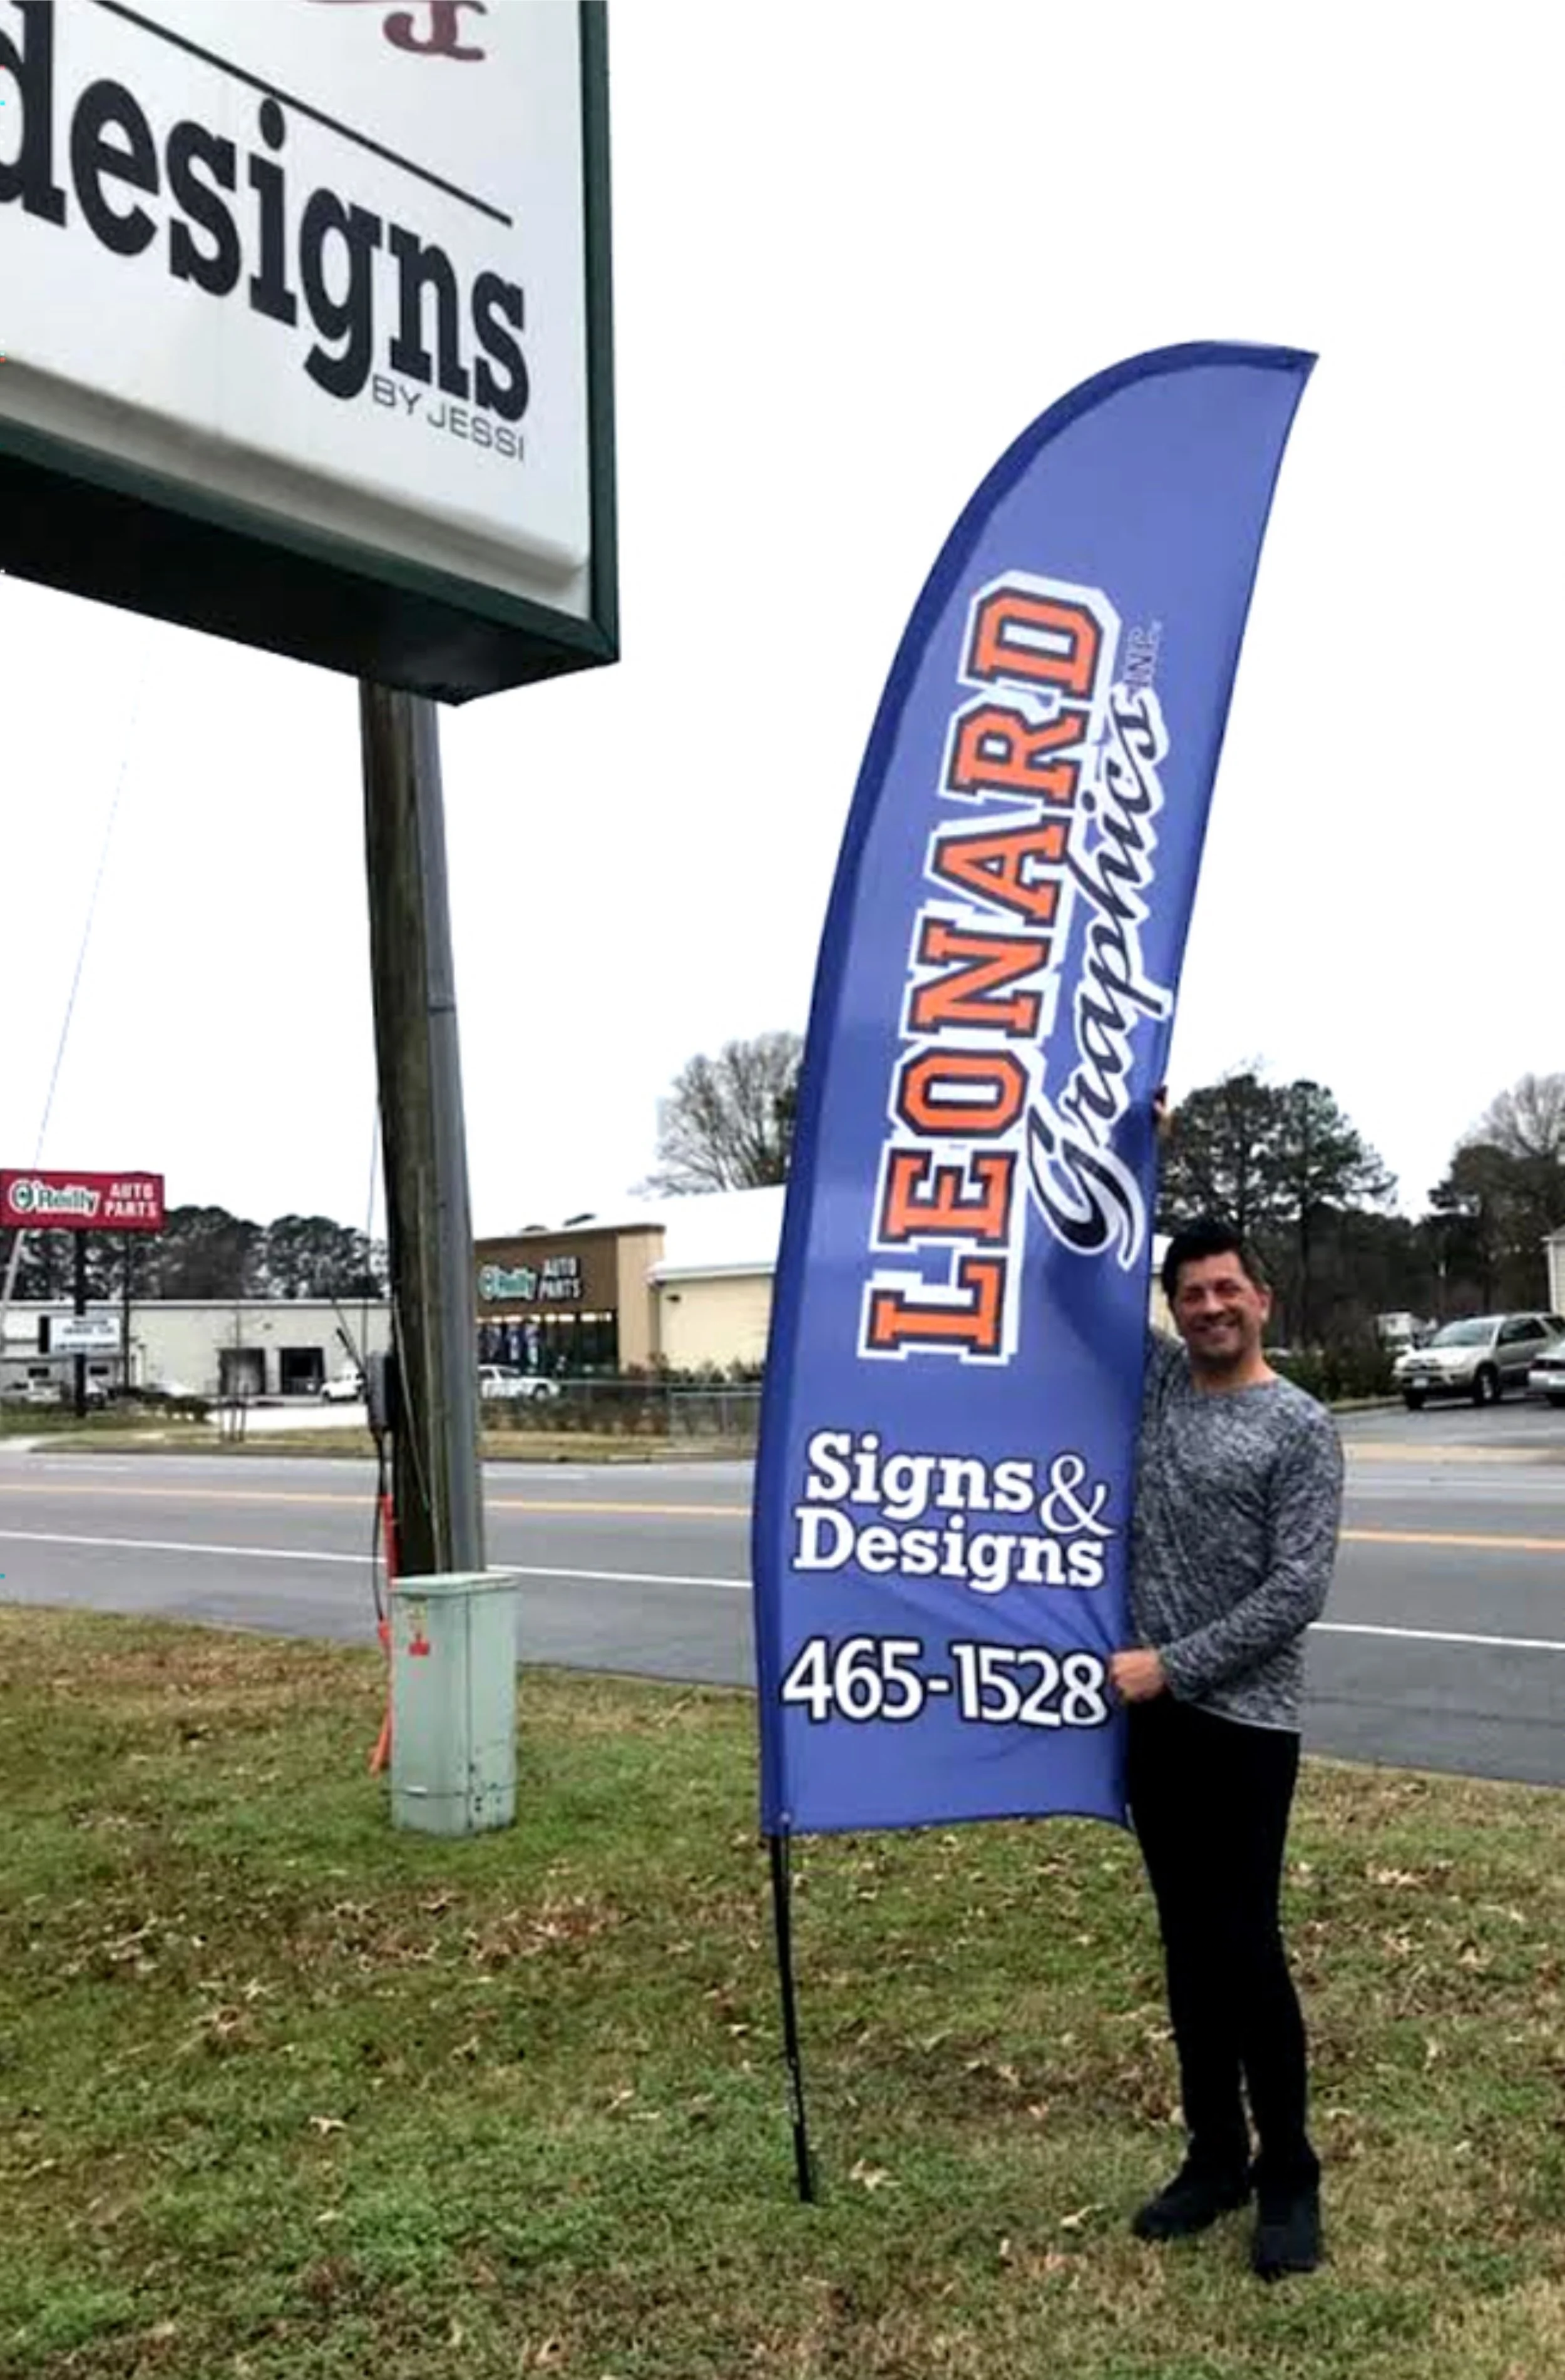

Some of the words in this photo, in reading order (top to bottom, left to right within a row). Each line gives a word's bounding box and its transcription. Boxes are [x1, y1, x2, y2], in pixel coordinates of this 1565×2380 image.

[372, 373, 421, 414] BY
[427, 402, 524, 461] JESSI
[858, 570, 1121, 1363] LEONARD
[1027, 684, 1172, 1270] Graphics
[104, 1201, 158, 1217] PARTS
[110, 1182, 154, 1199] AUTO
[806, 1430, 1035, 1521] Signs
[1039, 1454, 1116, 1537] &
[792, 1506, 1105, 1594] Designs
[780, 1636, 1108, 1728] 465-1528
